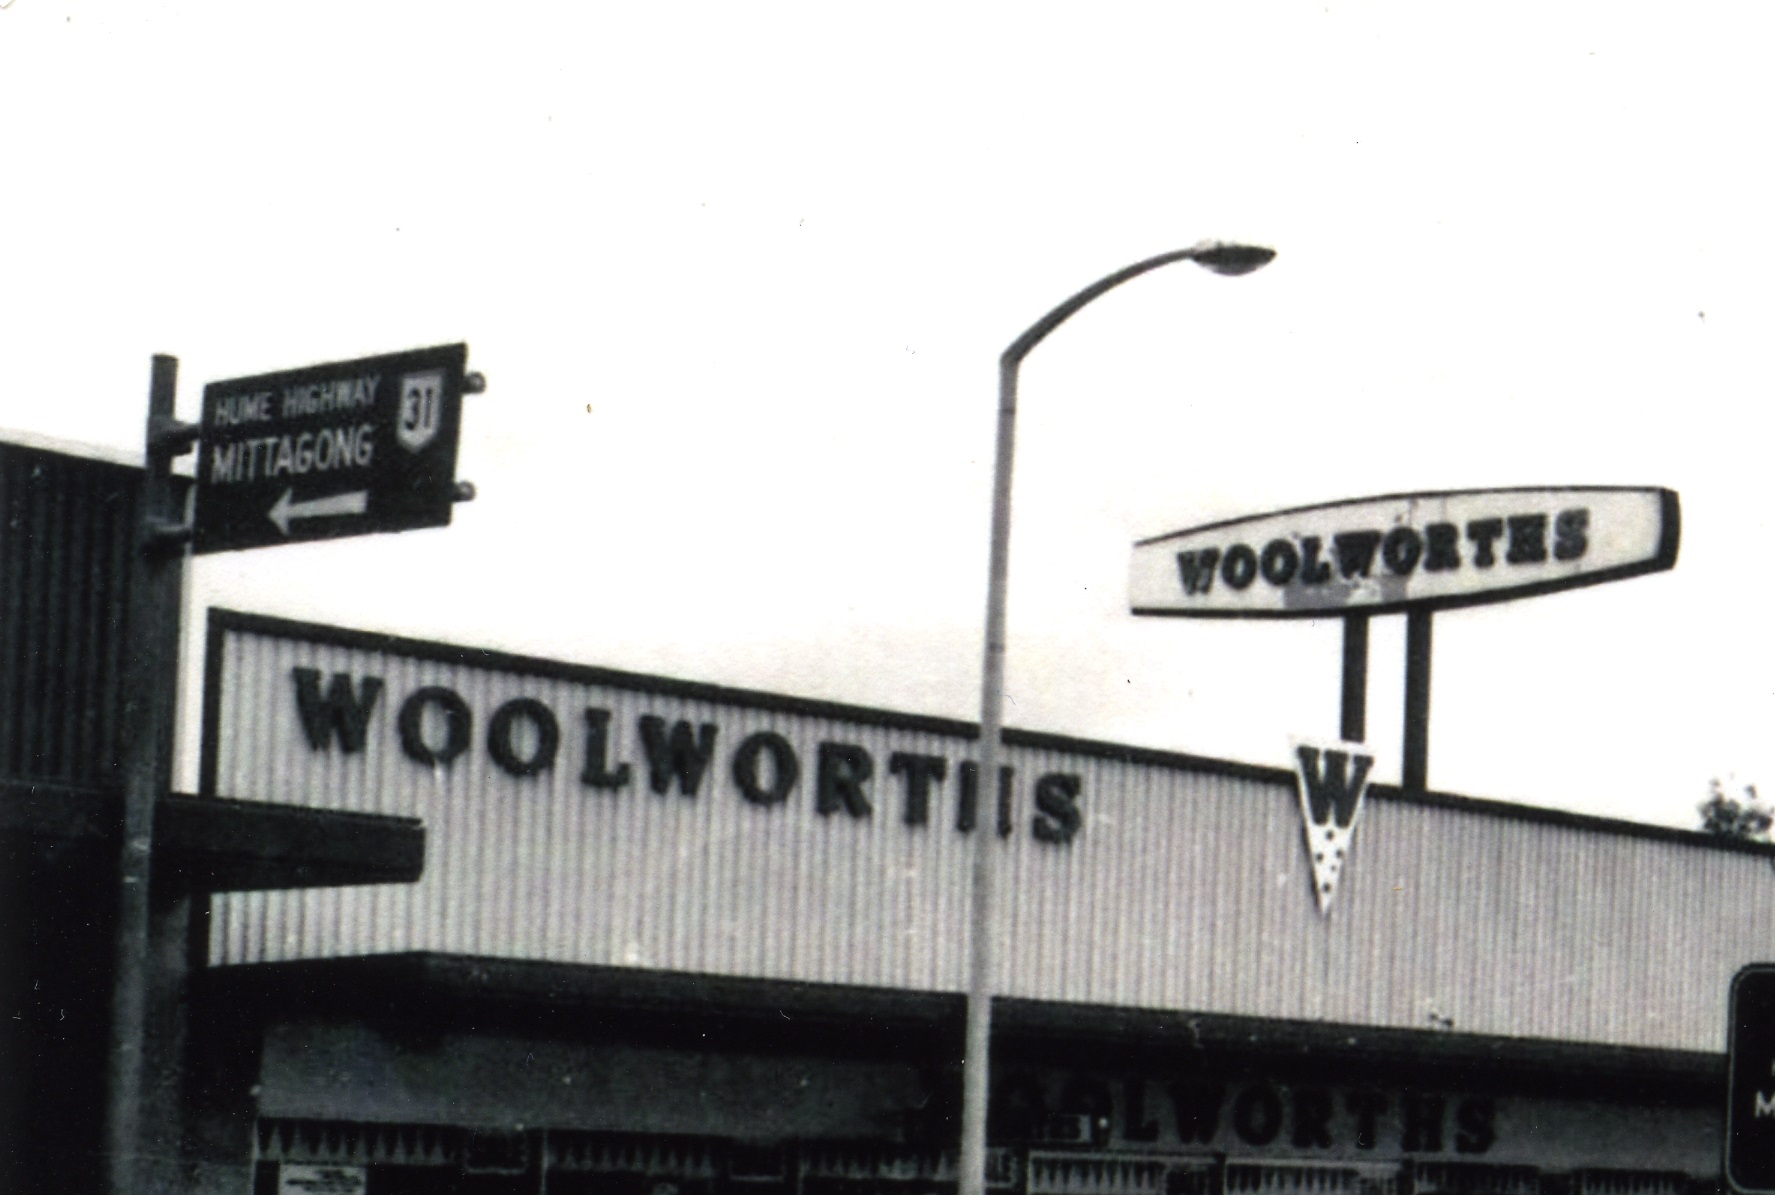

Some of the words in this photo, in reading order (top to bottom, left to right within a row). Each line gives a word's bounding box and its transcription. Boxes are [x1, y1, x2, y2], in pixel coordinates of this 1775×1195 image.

[215, 390, 273, 425] HUME
[281, 374, 382, 417] HIGHWAY
[404, 387, 435, 432] 31
[211, 423, 374, 485] MITTAGONG
[1177, 507, 1590, 596] WOOLWORTHS
[1296, 744, 1375, 829] W
